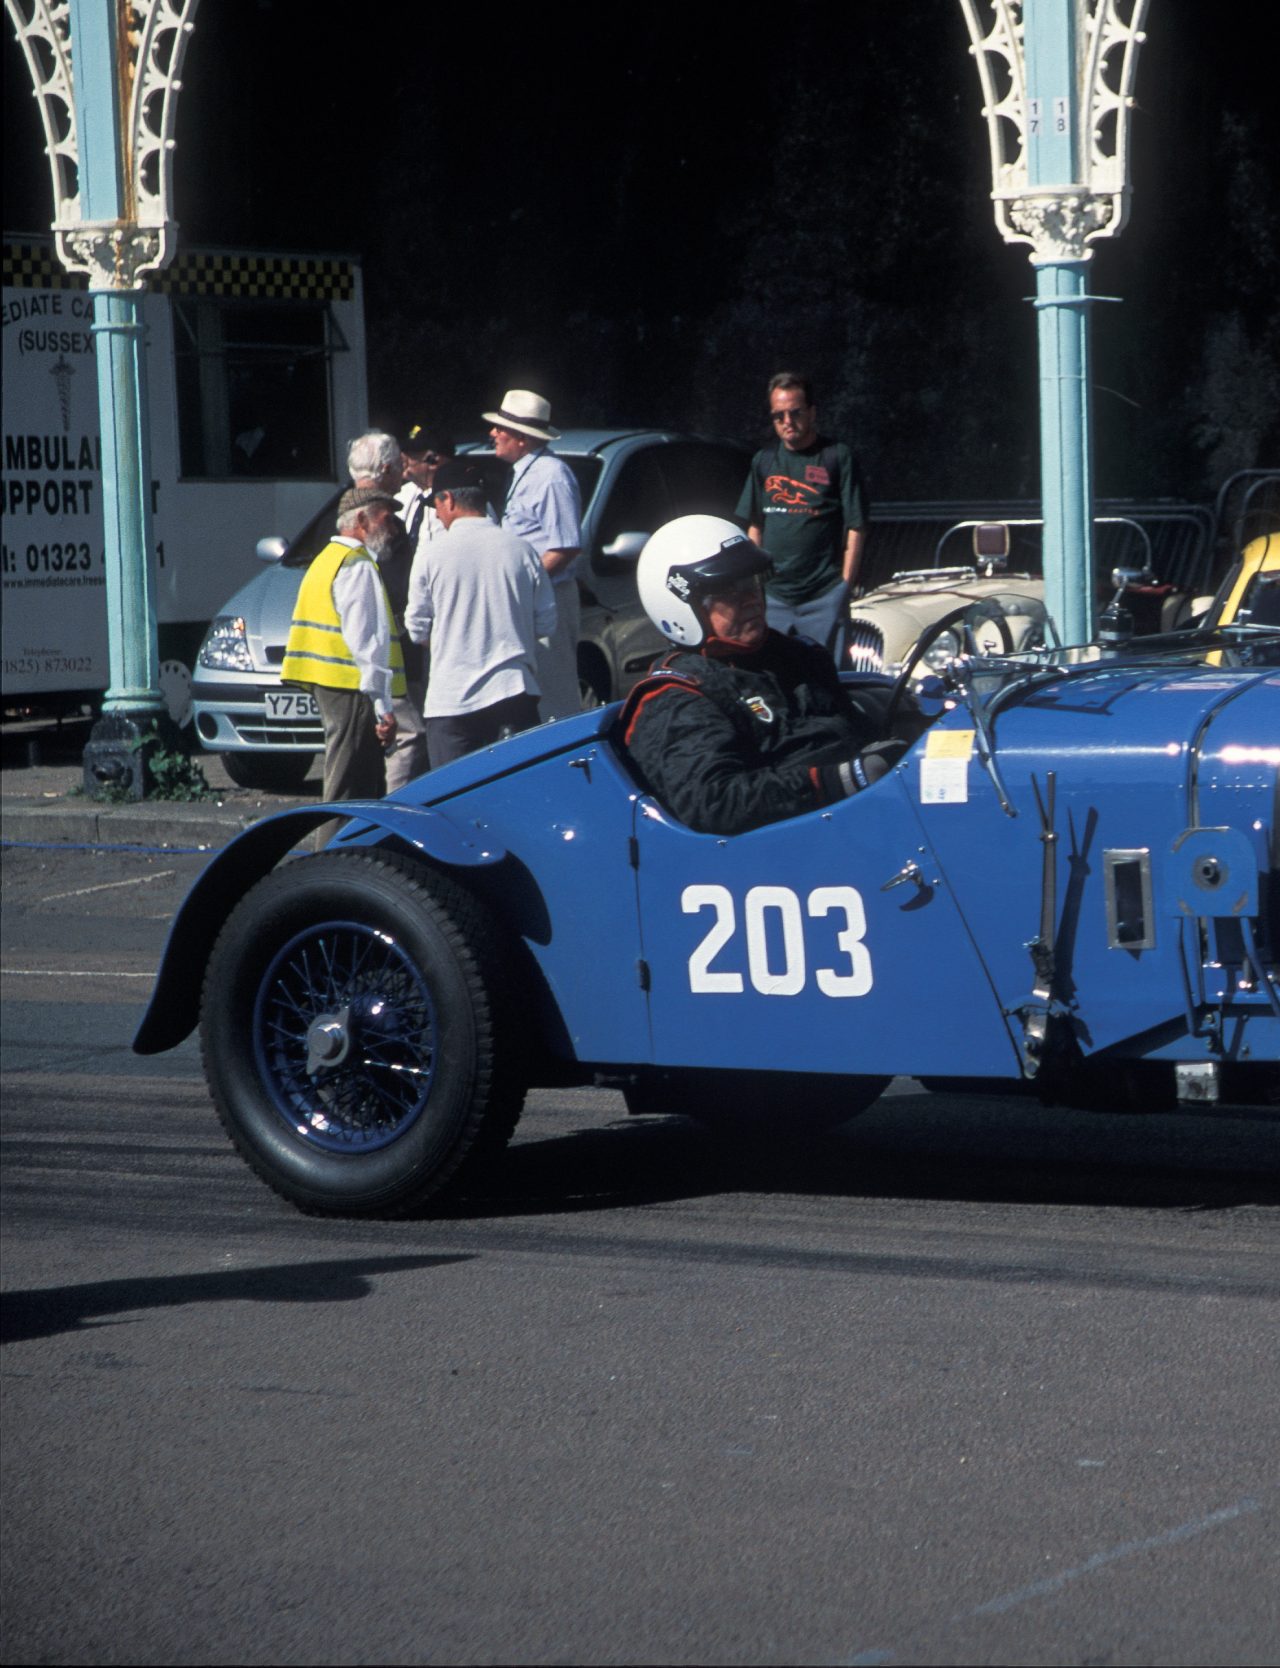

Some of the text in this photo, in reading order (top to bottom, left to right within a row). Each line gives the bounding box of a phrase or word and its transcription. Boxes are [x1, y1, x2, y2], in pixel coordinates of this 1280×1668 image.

[18, 328, 94, 356] (SUSSEX
[26, 542, 92, 572] 01323
[680, 884, 874, 998] 203
